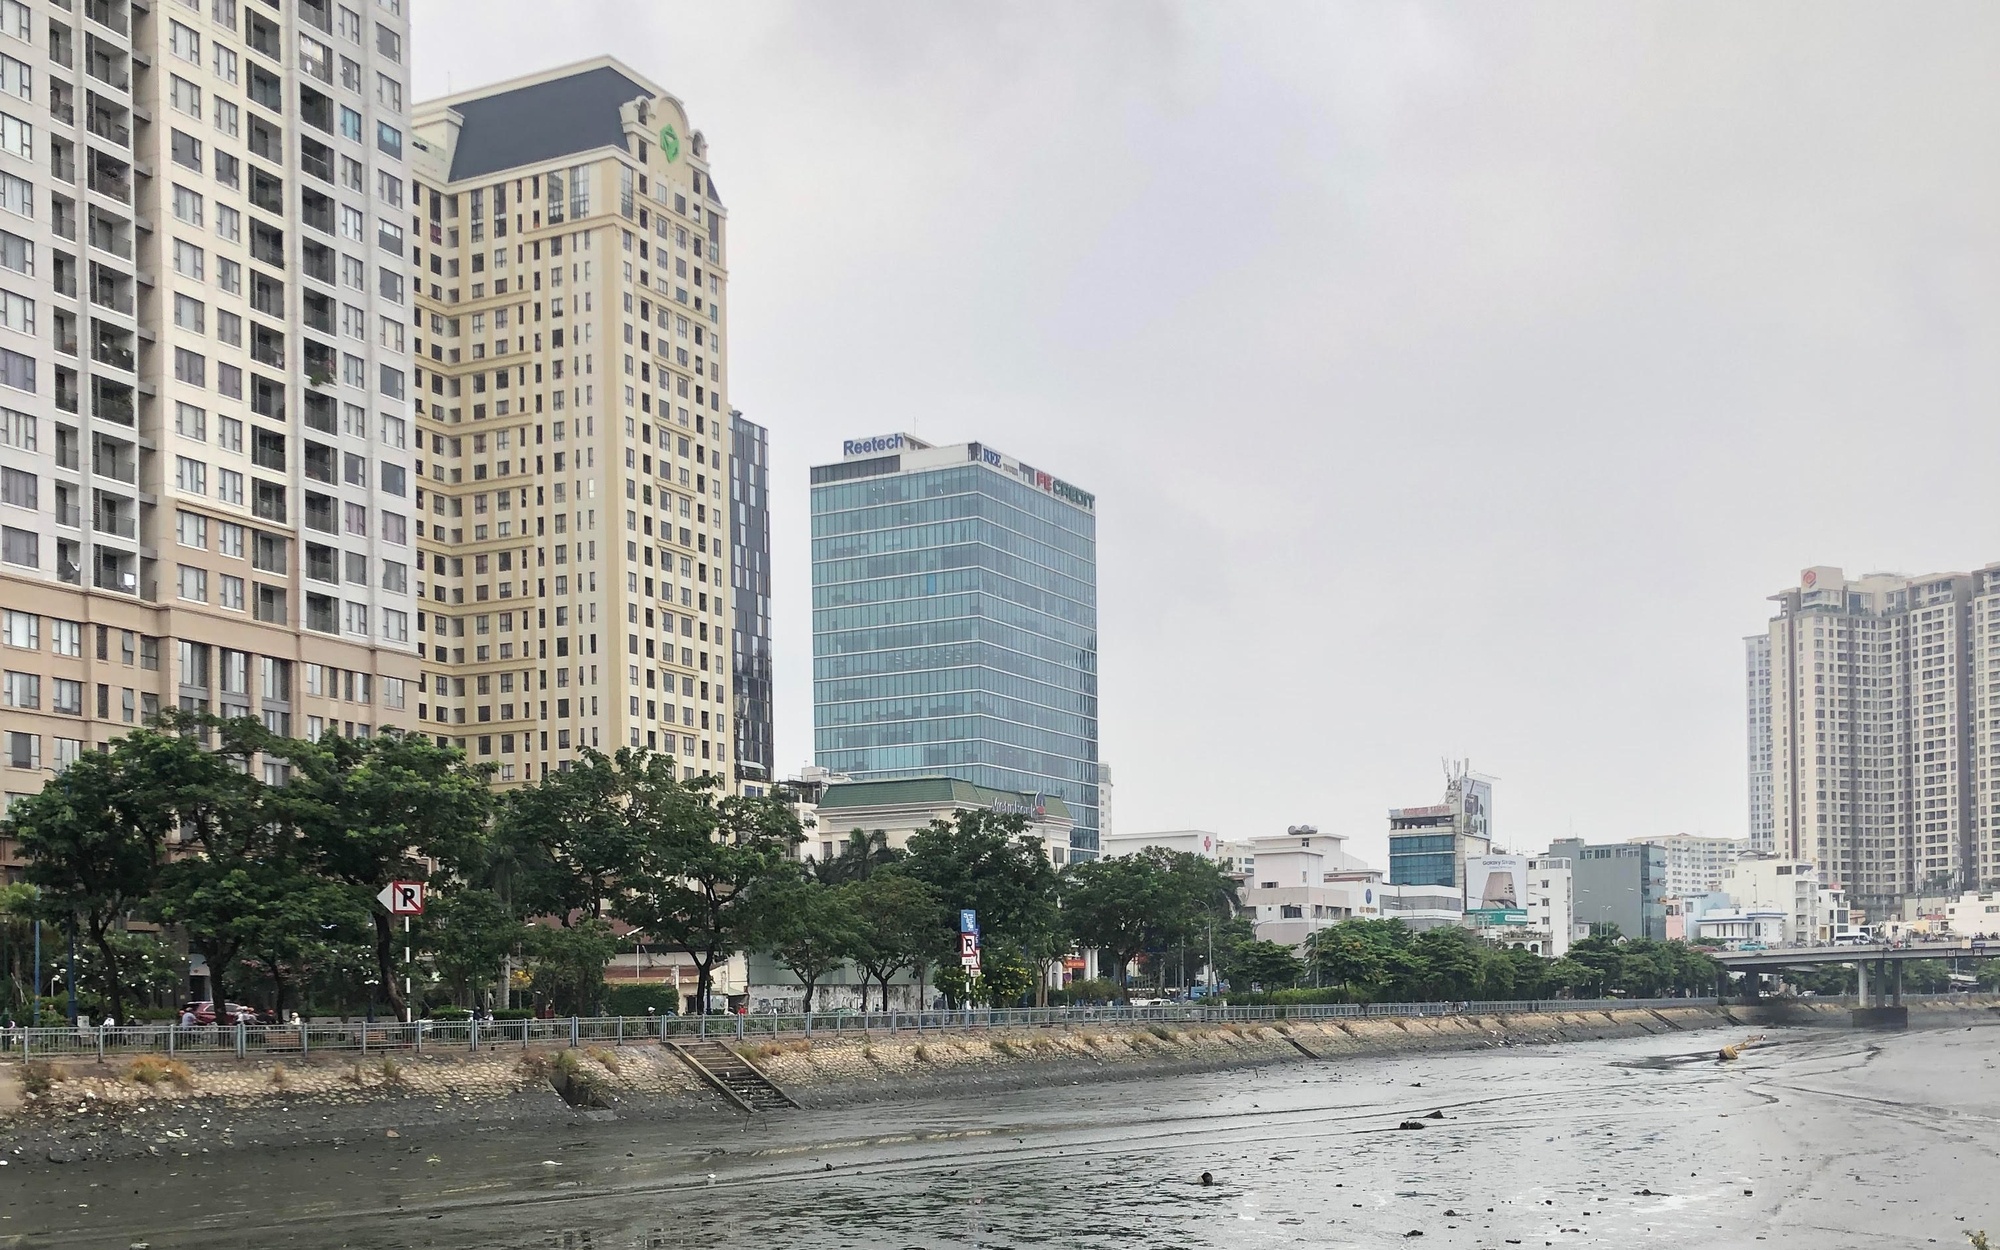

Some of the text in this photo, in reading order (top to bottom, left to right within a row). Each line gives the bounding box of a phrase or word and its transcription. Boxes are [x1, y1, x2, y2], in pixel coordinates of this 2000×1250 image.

[843, 433, 904, 456] Reetech
[982, 447, 1002, 468] REE
[1036, 471, 1096, 510] FE CREDIT
[402, 887, 416, 907] P
